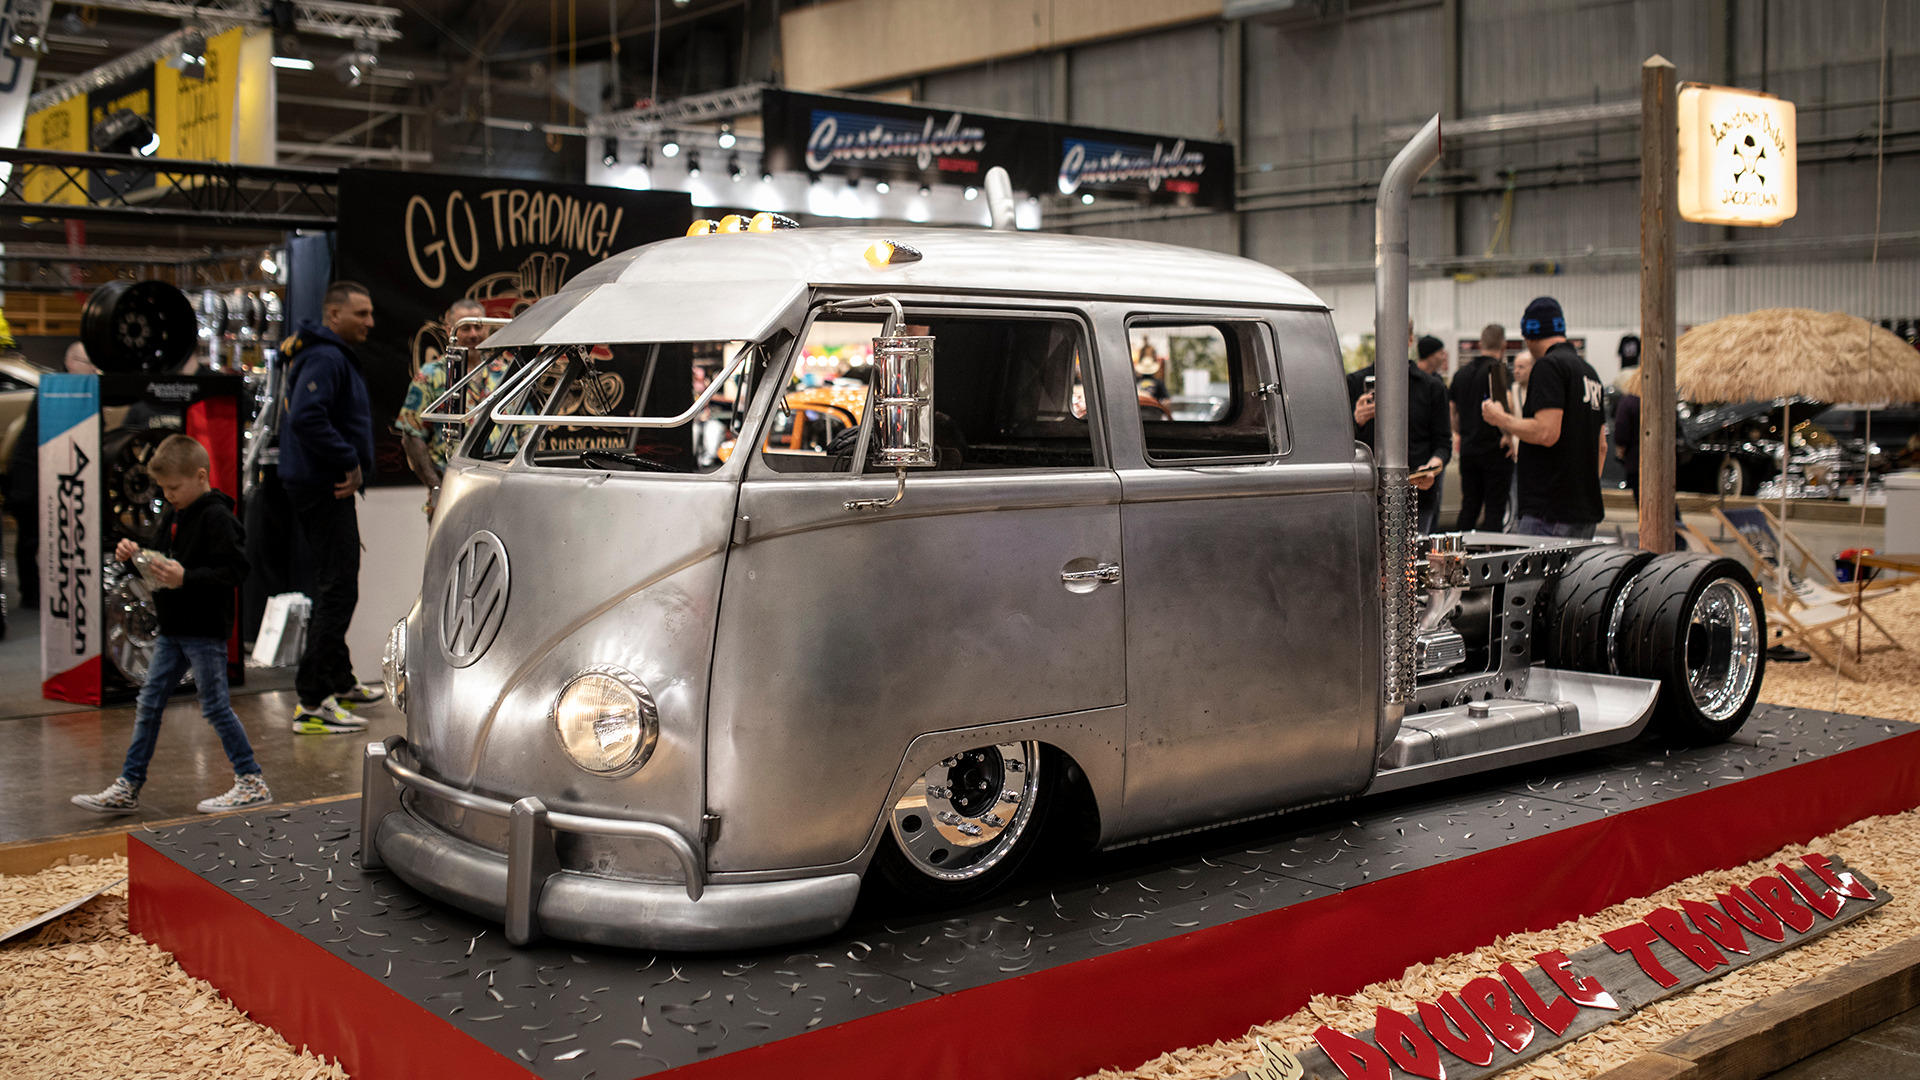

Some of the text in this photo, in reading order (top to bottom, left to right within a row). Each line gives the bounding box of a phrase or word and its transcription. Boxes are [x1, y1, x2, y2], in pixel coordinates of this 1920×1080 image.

[405, 189, 624, 289] GO TRADING!
[50, 474, 74, 620] Racing
[72, 442, 91, 656] American
[1312, 853, 1877, 1080] DOUBLE TROUBLE
